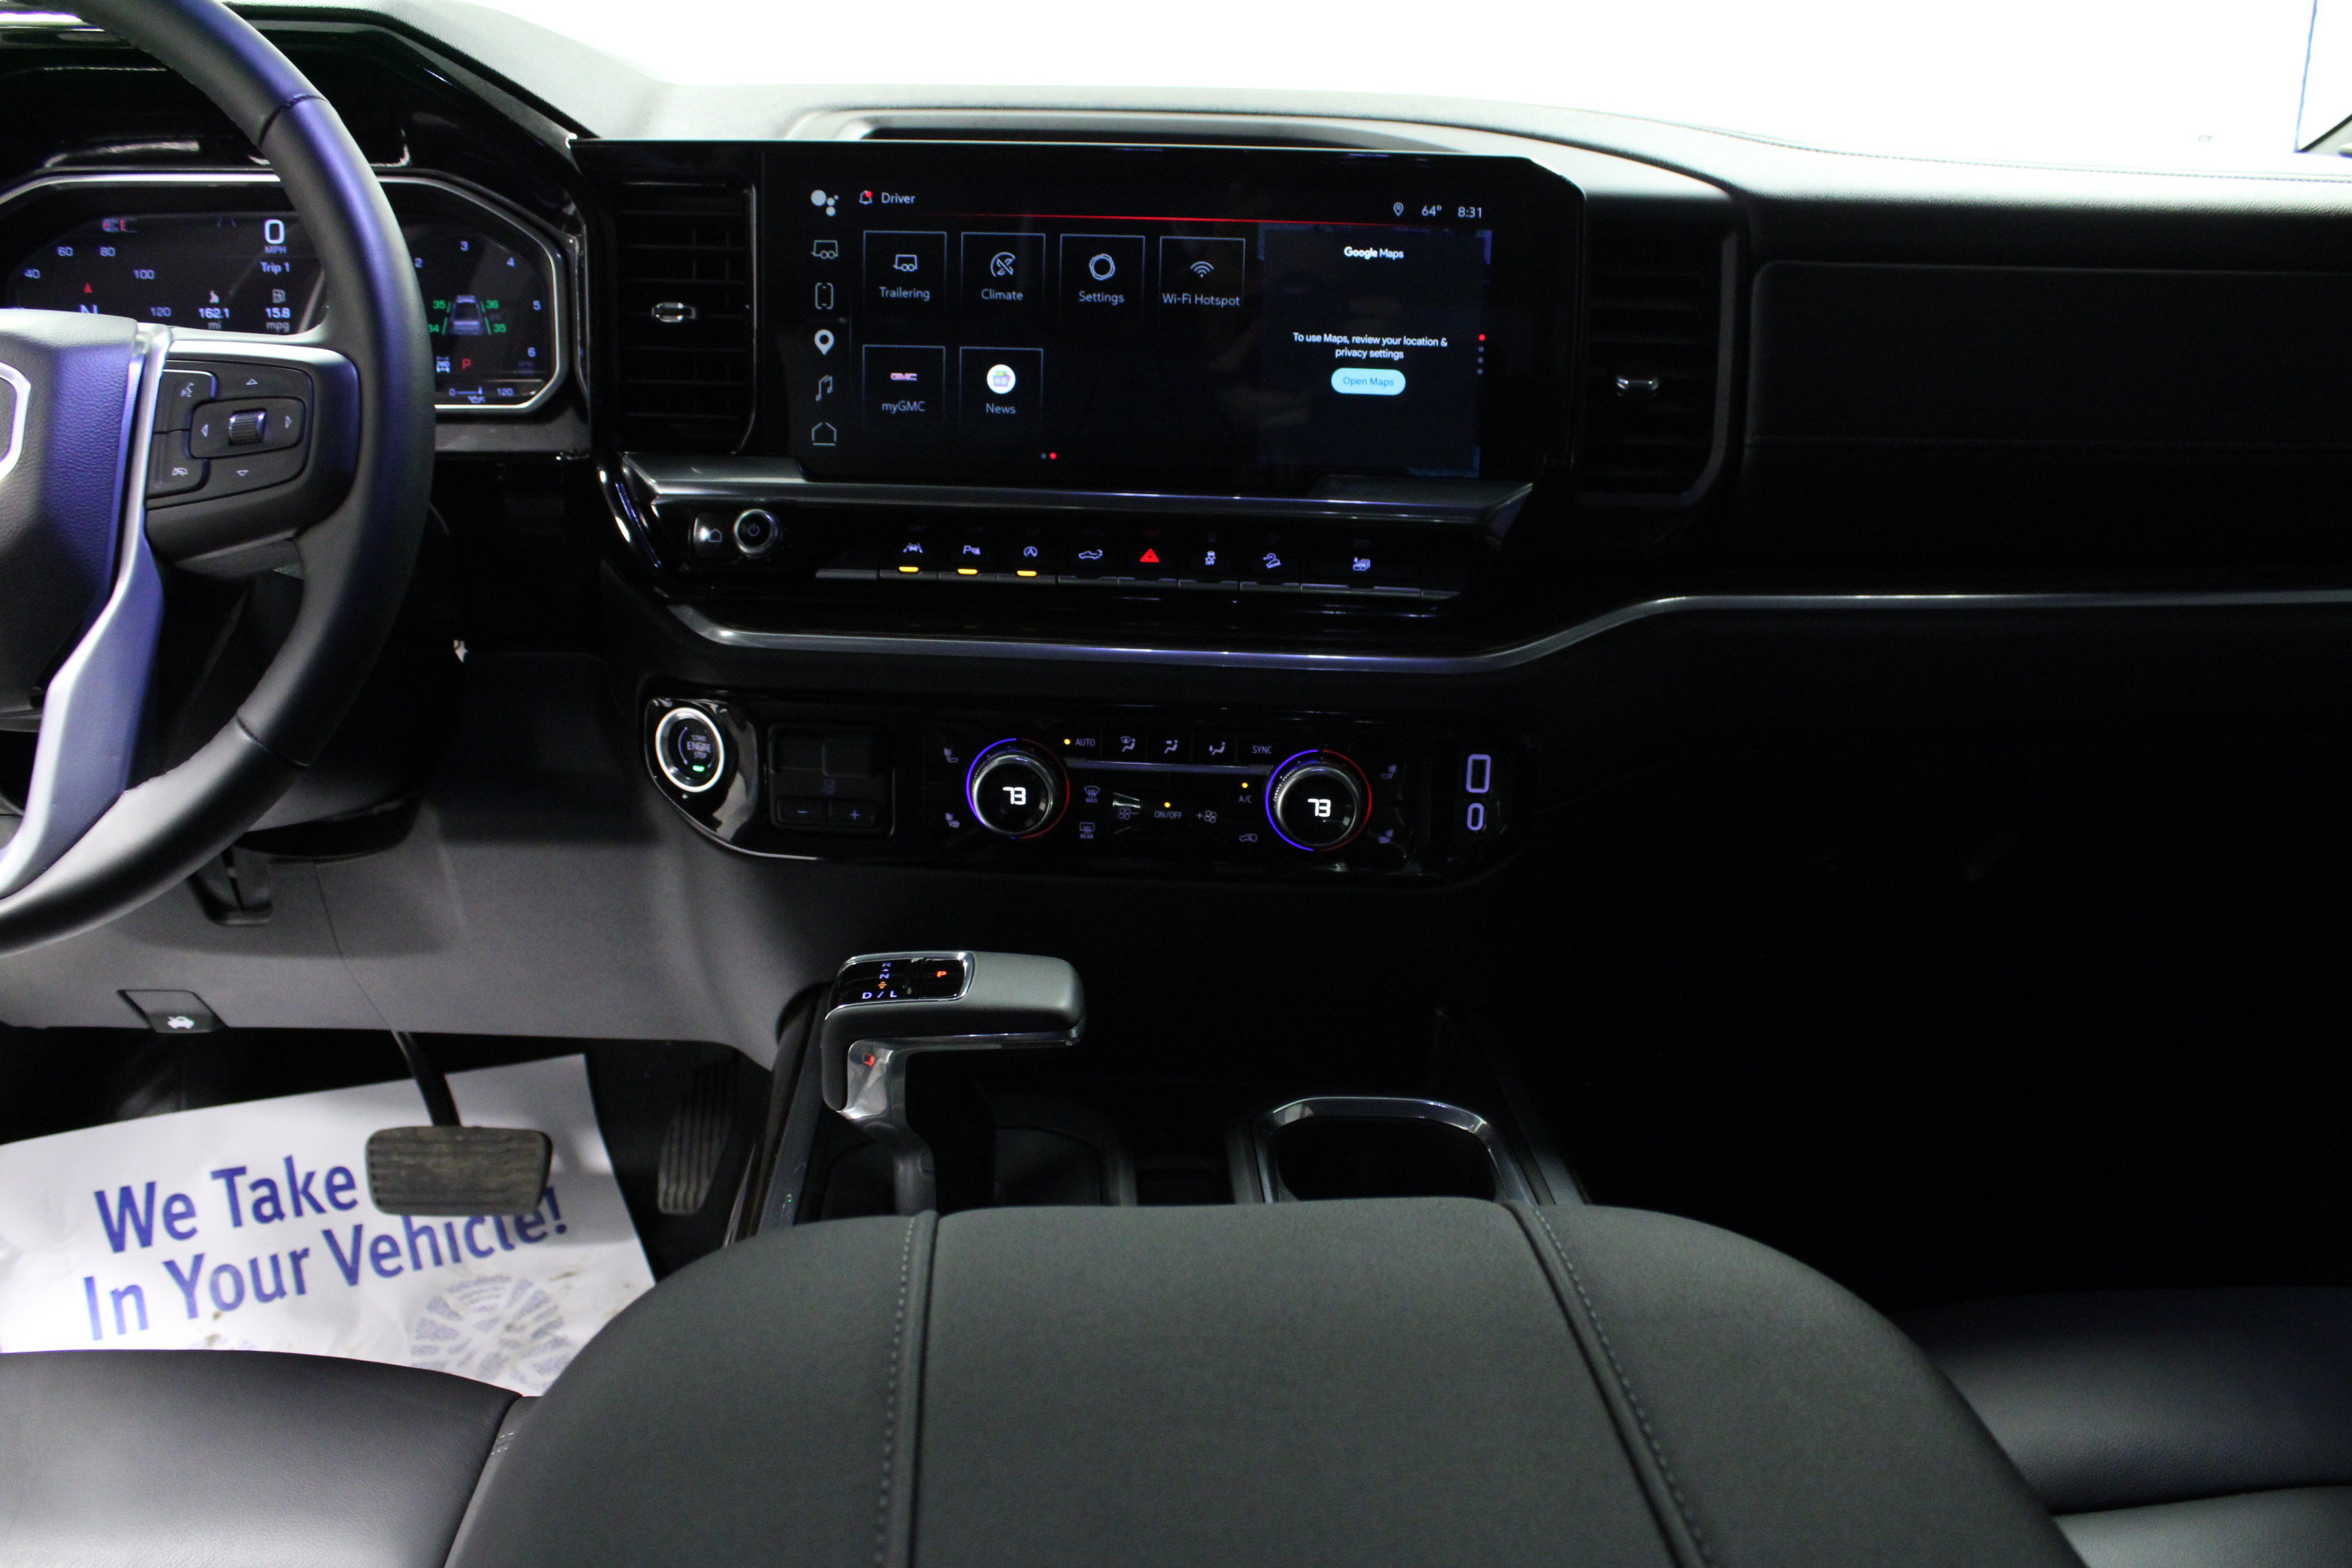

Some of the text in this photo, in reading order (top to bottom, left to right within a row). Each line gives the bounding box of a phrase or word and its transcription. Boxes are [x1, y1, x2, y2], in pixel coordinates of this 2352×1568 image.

[881, 192, 916, 204] Driver
[1458, 206, 1482, 218] 8:31
[264, 219, 285, 244] 0
[264, 246, 287, 254] MPH
[460, 241, 469, 251] 3
[57, 247, 73, 257] 60
[99, 247, 116, 257] 80
[1344, 246, 1404, 260] Google Maps
[414, 257, 423, 268] 2
[507, 257, 515, 267] 4
[24, 269, 41, 279] 40
[133, 269, 155, 279] 100
[260, 262, 290, 275] Trip 1
[879, 286, 930, 302] Trailering
[981, 288, 1024, 300] Climate
[1079, 290, 1125, 306] Settings
[432, 300, 447, 309] 35
[533, 300, 542, 311] 5
[1162, 293, 1240, 308] Wi-Fi Hotspot
[151, 307, 172, 316] 120
[266, 322, 290, 332] mpg
[1293, 332, 1448, 347] To use Maps, review your location &
[527, 347, 537, 358] 6
[1335, 347, 1404, 361] privacy settings
[462, 358, 471, 370] P
[1343, 376, 1394, 387] Open Maps
[881, 400, 926, 415] myGMC
[985, 403, 1017, 414] News
[1075, 738, 1096, 747] AUTO
[1252, 746, 1272, 754] SYNC
[1002, 786, 1027, 805] 73
[1239, 795, 1252, 803] A/C
[1307, 799, 1331, 818] 73
[1154, 811, 1182, 819] ON/OFF
[94, 1155, 358, 1254] We Take
[83, 1274, 150, 1341] In
[163, 1246, 311, 1320] Your
